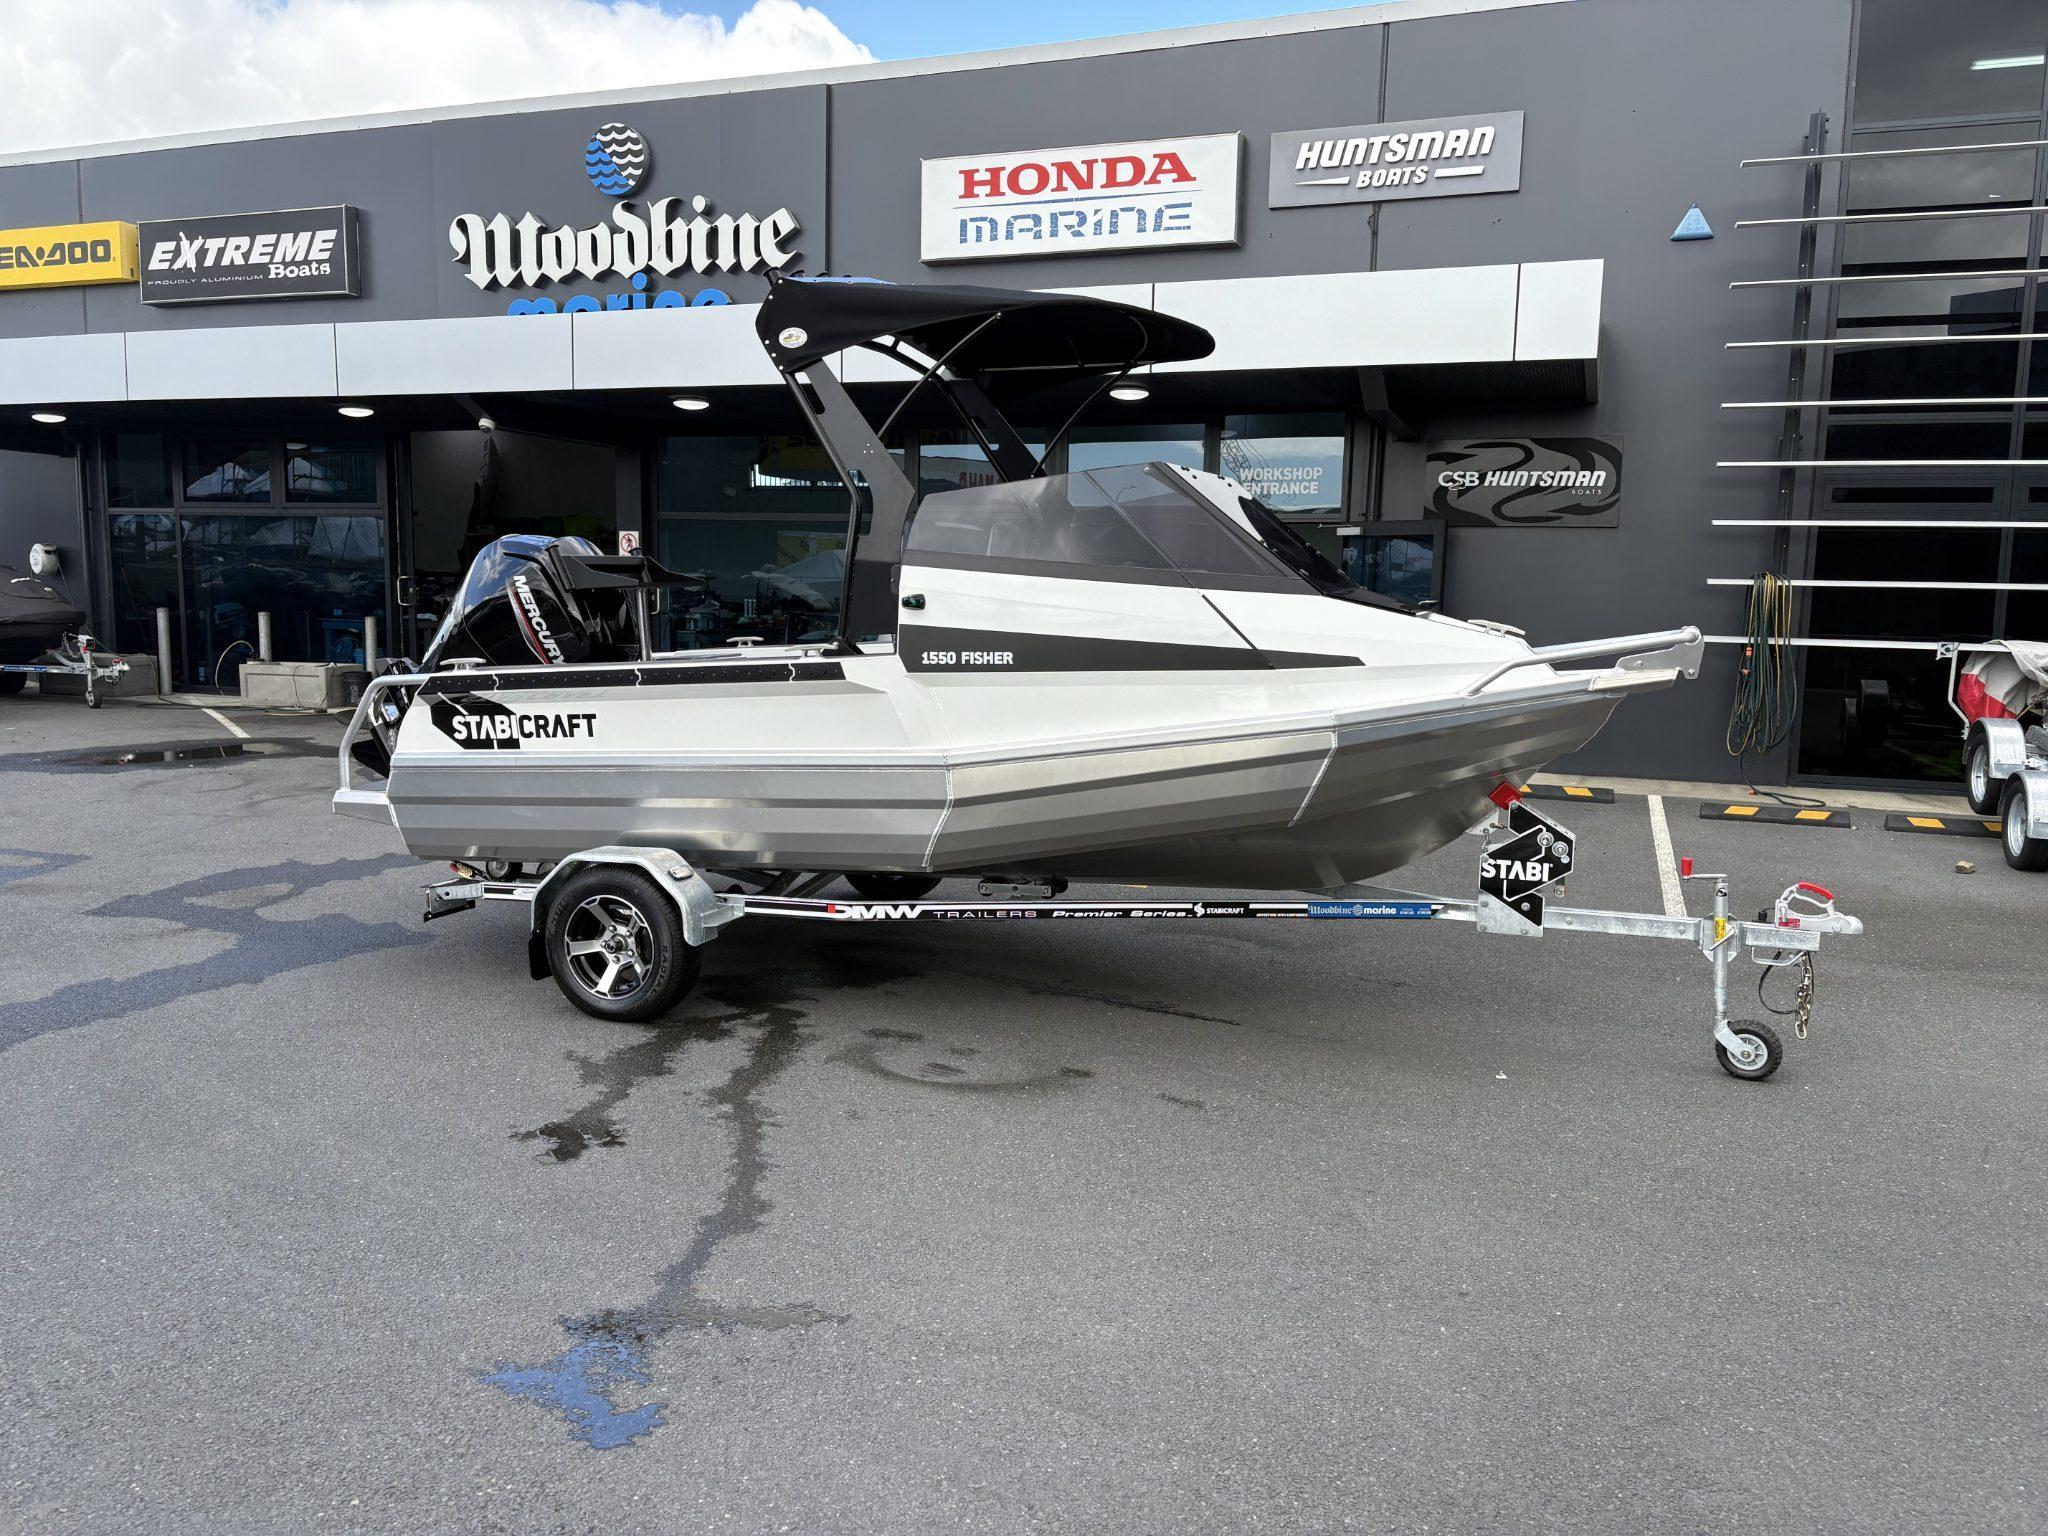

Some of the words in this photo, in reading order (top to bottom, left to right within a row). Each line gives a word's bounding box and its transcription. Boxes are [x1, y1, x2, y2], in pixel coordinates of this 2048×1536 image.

[1295, 126, 1496, 170] HUNTSMAN
[959, 152, 1196, 199] HONDA
[1356, 165, 1429, 188] BOATS
[959, 202, 1193, 244] MARINE
[148, 229, 338, 273] EXTREME
[449, 195, 800, 290] Woodbine
[201, 274, 263, 283] ALUMINIUM
[268, 261, 331, 279] Boats
[1240, 467, 1323, 480] WORKSHOP
[1438, 471, 1480, 488] CSB
[1483, 470, 1607, 487] HUNTSMAN
[1242, 482, 1319, 495] ENTRANCE
[513, 575, 567, 664] MERCURY
[921, 651, 957, 665] 1550
[961, 651, 1014, 665] FISHER
[452, 713, 597, 741] STABICRAFT
[1481, 858, 1550, 882] STABI
[1130, 910, 1187, 918] Series
[1308, 904, 1352, 915] Woodbine
[1363, 905, 1397, 915] marine
